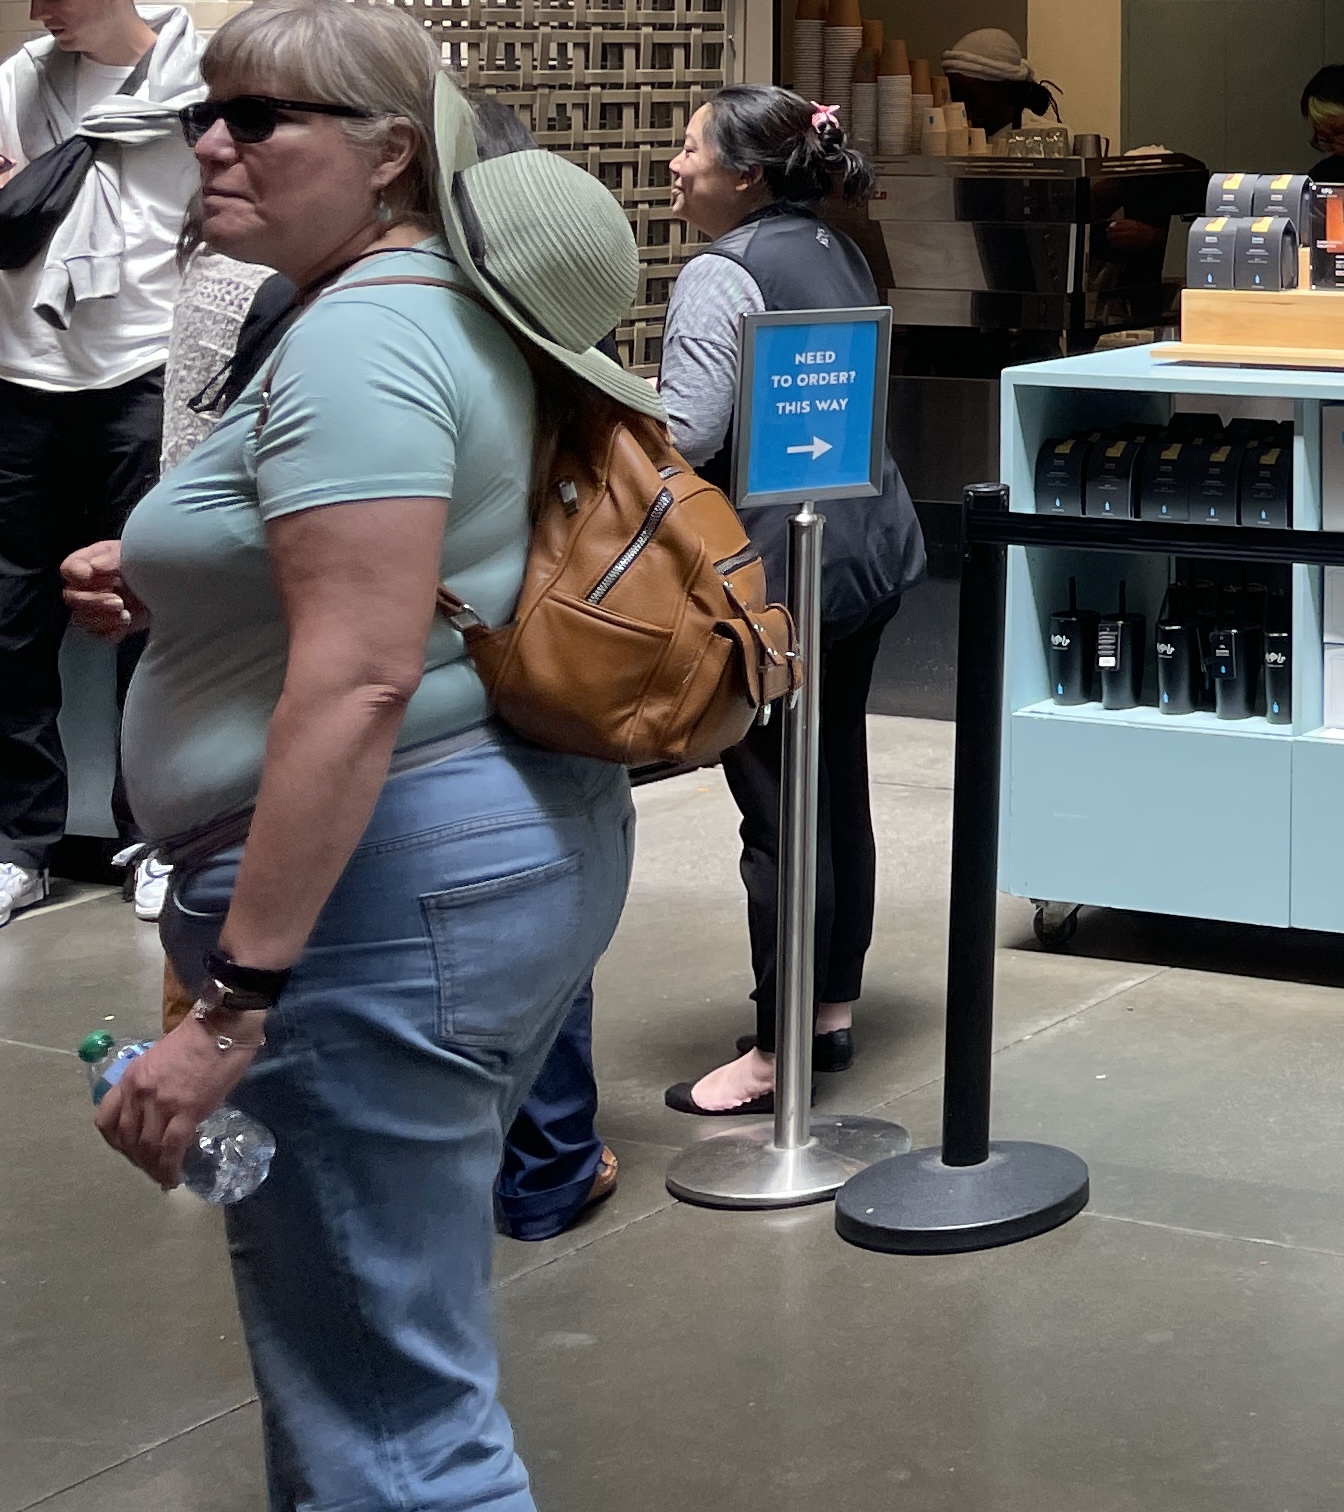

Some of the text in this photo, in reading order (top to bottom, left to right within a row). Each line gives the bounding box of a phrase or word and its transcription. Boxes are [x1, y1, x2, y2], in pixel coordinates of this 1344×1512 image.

[795, 350, 836, 365] NEED
[771, 371, 856, 388] TO ORDER?
[776, 398, 849, 415] THIS WAY
